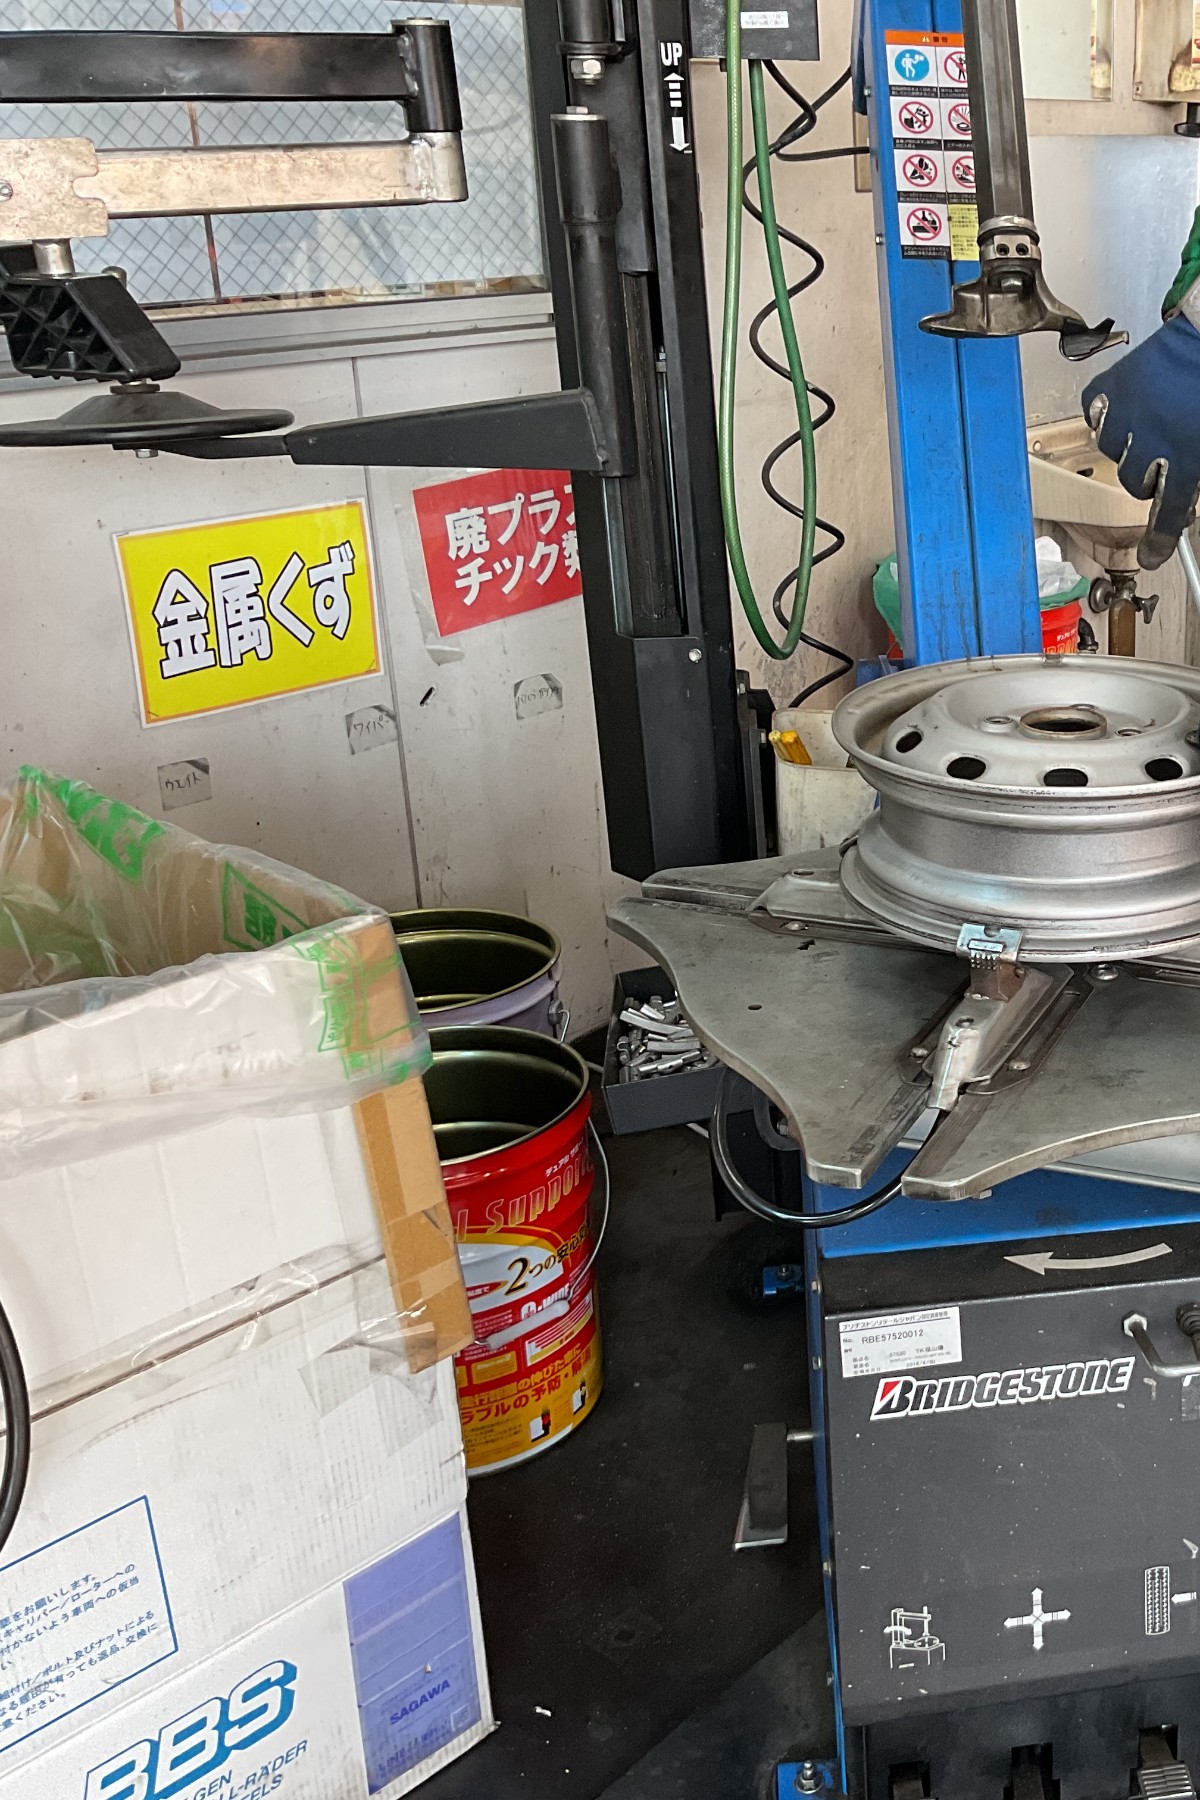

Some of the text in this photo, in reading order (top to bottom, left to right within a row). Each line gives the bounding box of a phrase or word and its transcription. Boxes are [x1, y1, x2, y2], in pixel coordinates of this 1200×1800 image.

[660, 42, 683, 67] UP
[153, 539, 356, 681] 金属くず
[861, 1329, 924, 1344] RBE57520012
[870, 1356, 1136, 1421] BRIDGESTONE
[0, 1692, 66, 1732] 意ください。
[389, 1679, 450, 1725] SAGAWA
[84, 1659, 298, 1800] BBS
[184, 1769, 232, 1800] GEN
